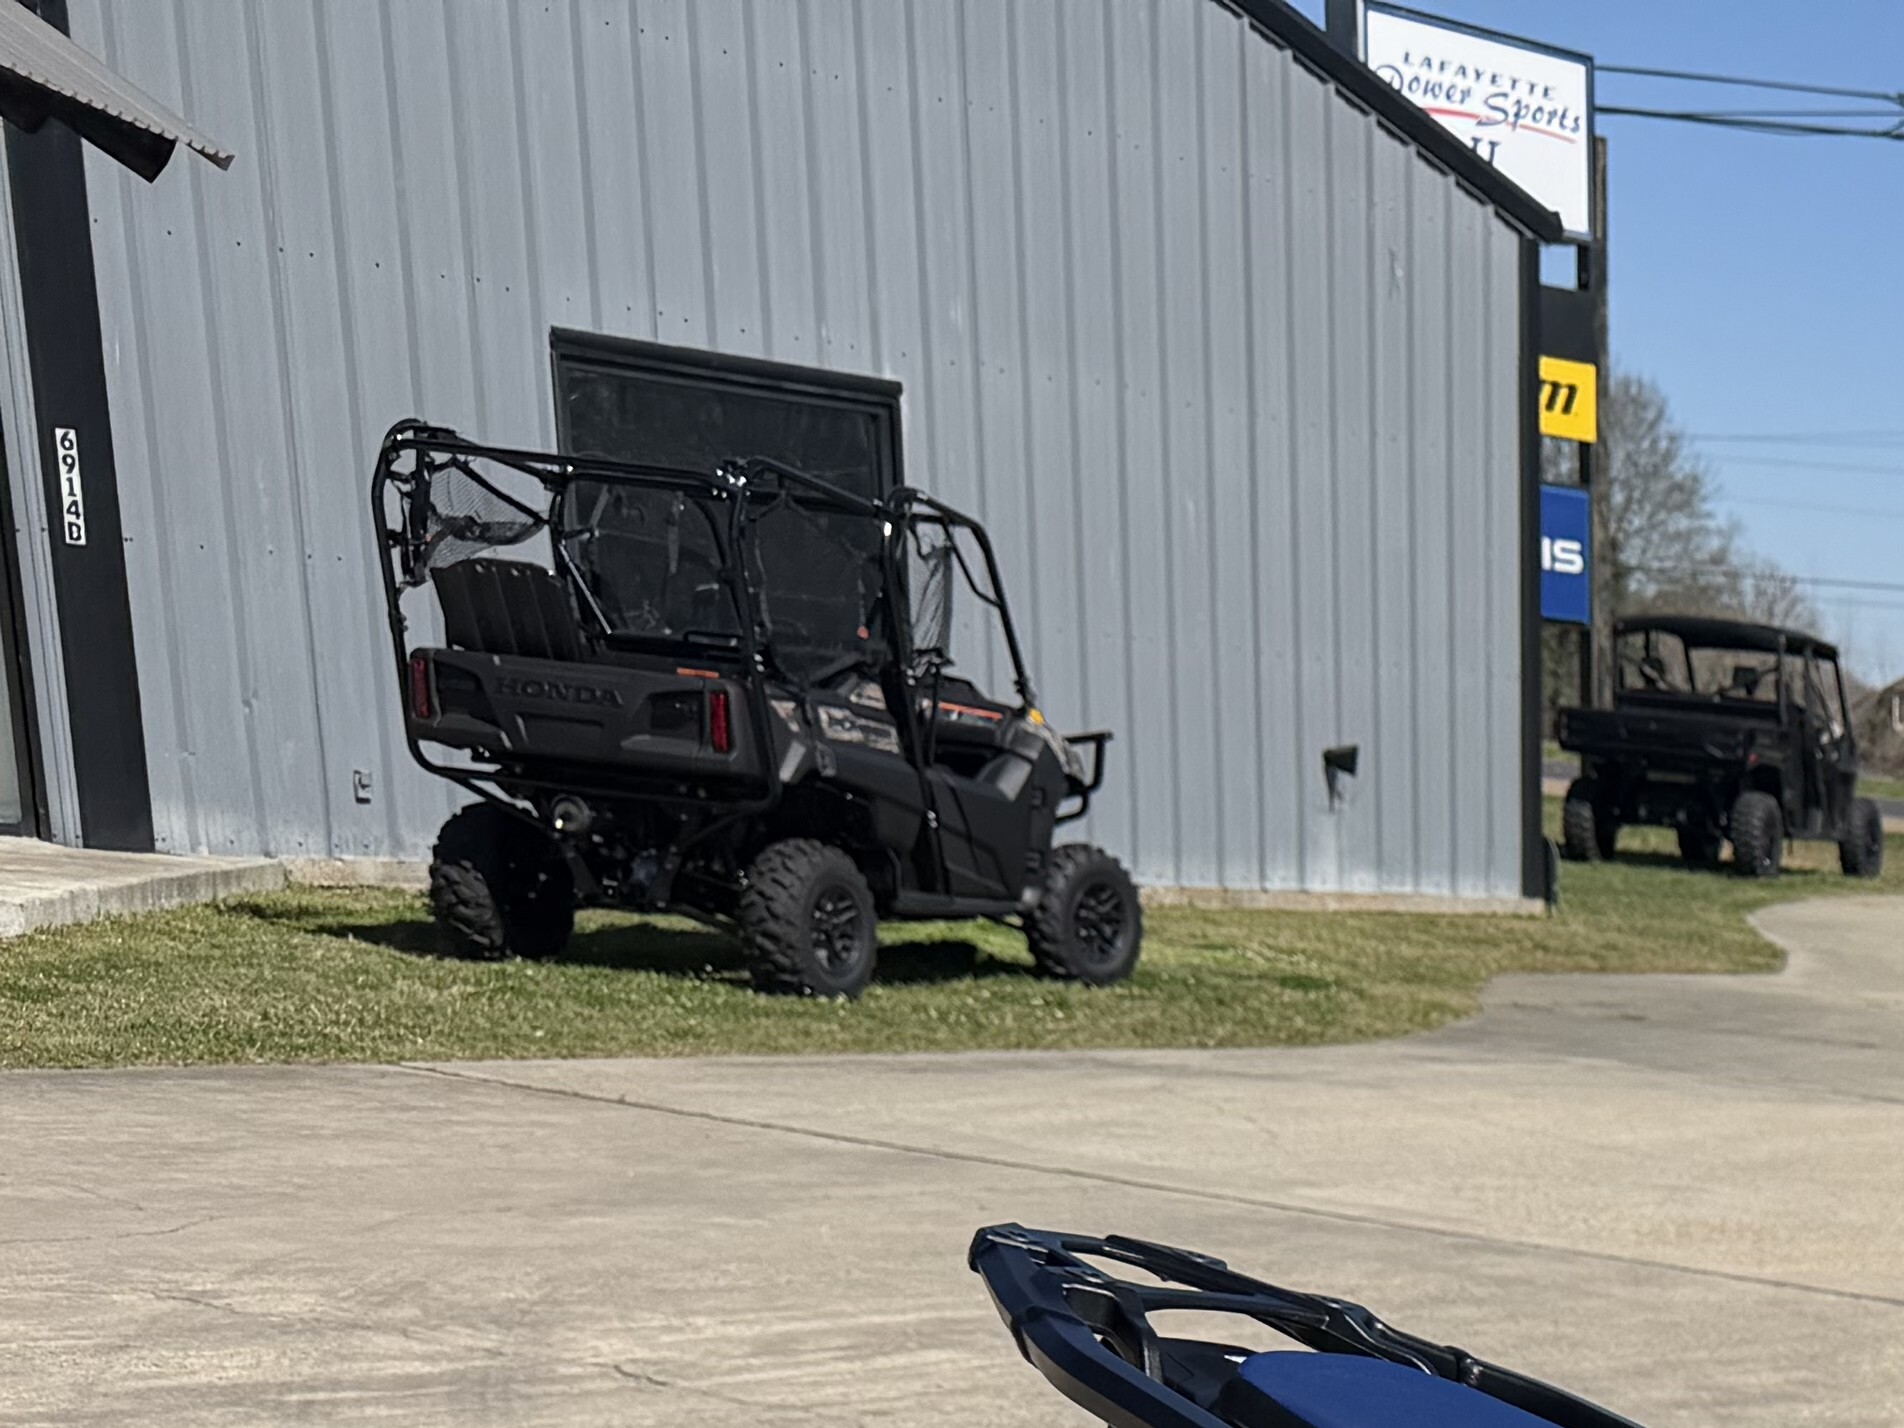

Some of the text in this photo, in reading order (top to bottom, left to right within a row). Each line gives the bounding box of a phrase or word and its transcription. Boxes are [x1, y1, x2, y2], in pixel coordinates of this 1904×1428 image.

[1375, 64, 1581, 134] Power Sports
[1403, 51, 1557, 101] LAFAYETTE
[497, 677, 625, 708] HONDA
